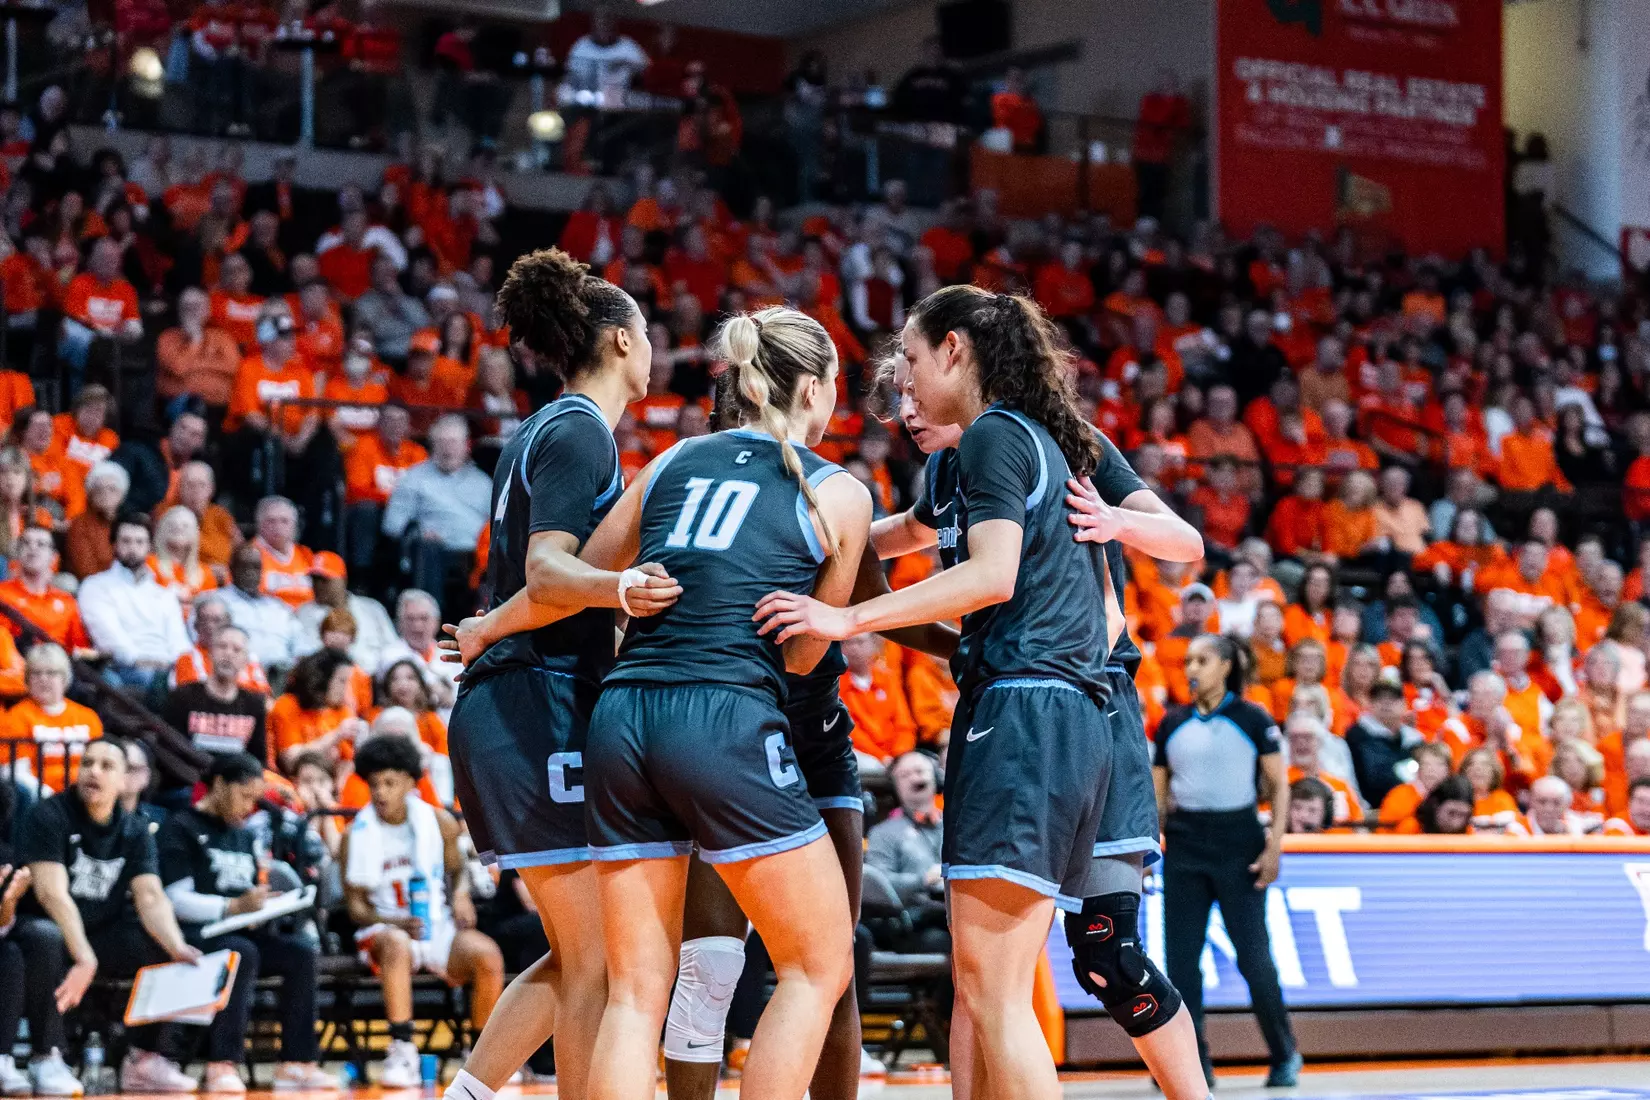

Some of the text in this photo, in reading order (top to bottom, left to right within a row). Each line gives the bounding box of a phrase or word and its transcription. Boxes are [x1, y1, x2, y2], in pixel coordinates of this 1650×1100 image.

[735, 450, 753, 465] C
[665, 477, 760, 551] 10
[547, 751, 585, 804] C
[764, 732, 800, 789] C
